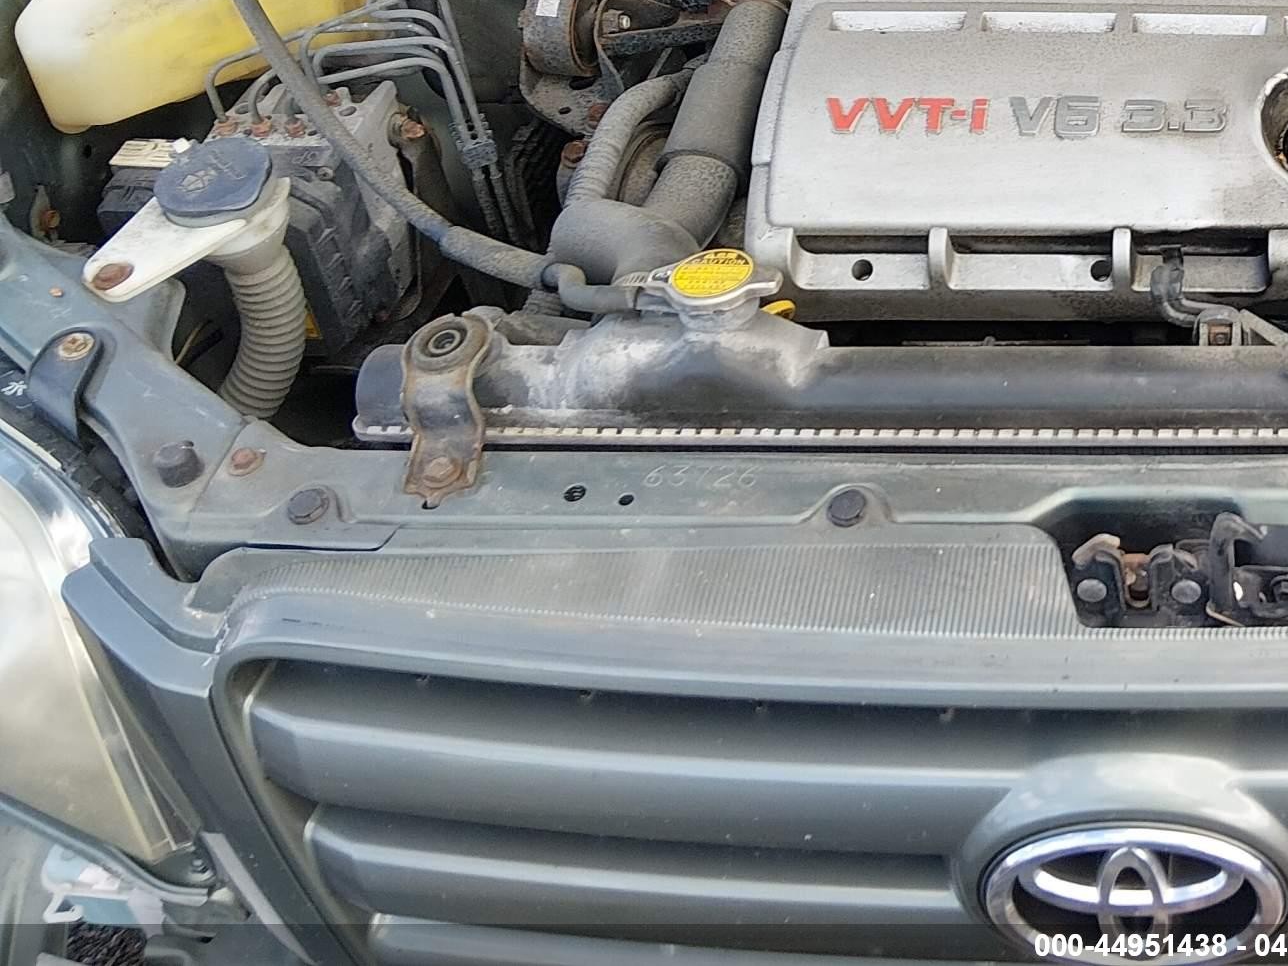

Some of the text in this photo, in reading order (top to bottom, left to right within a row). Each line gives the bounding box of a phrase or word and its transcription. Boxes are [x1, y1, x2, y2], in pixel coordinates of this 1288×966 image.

[827, 95, 1229, 138] VVT-i V6 3.3
